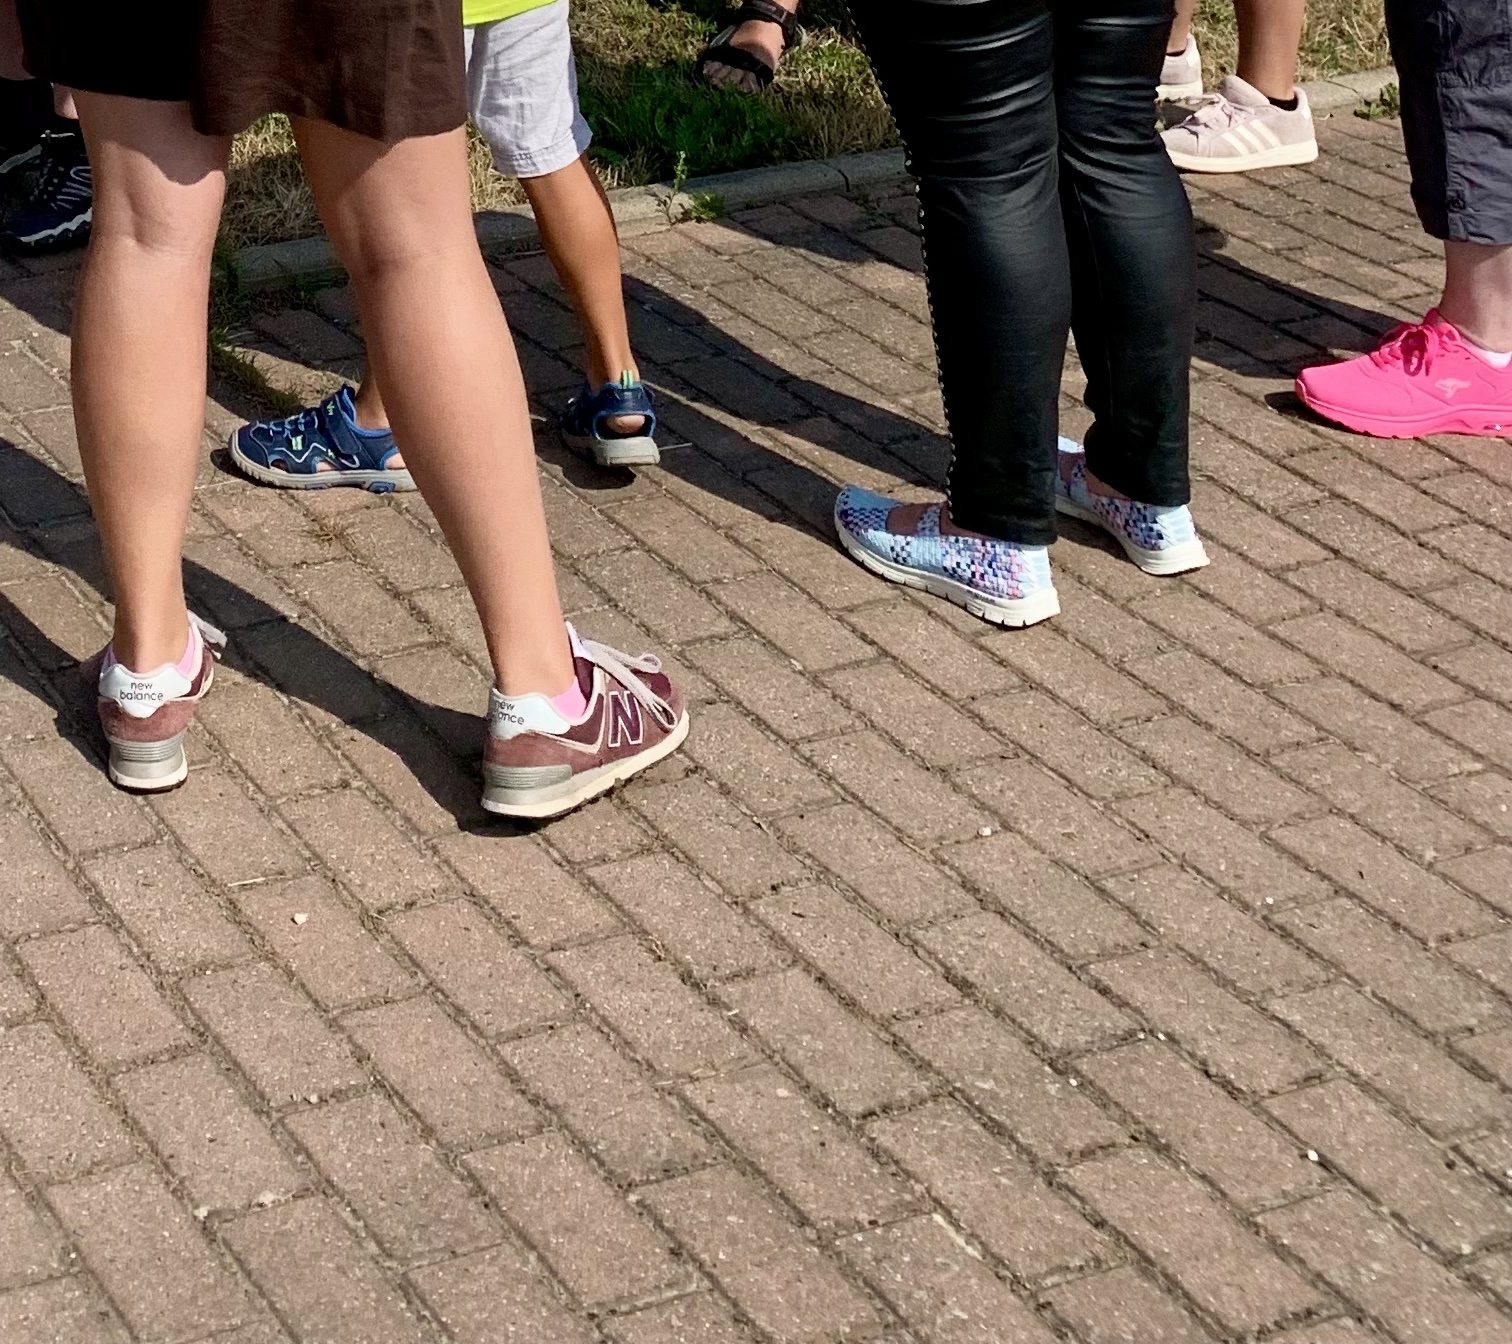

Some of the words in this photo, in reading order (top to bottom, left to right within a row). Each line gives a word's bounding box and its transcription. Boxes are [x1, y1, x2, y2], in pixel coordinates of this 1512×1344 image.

[130, 681, 154, 691] new
[119, 689, 164, 701] balance
[494, 699, 516, 712] new
[607, 691, 644, 748] N
